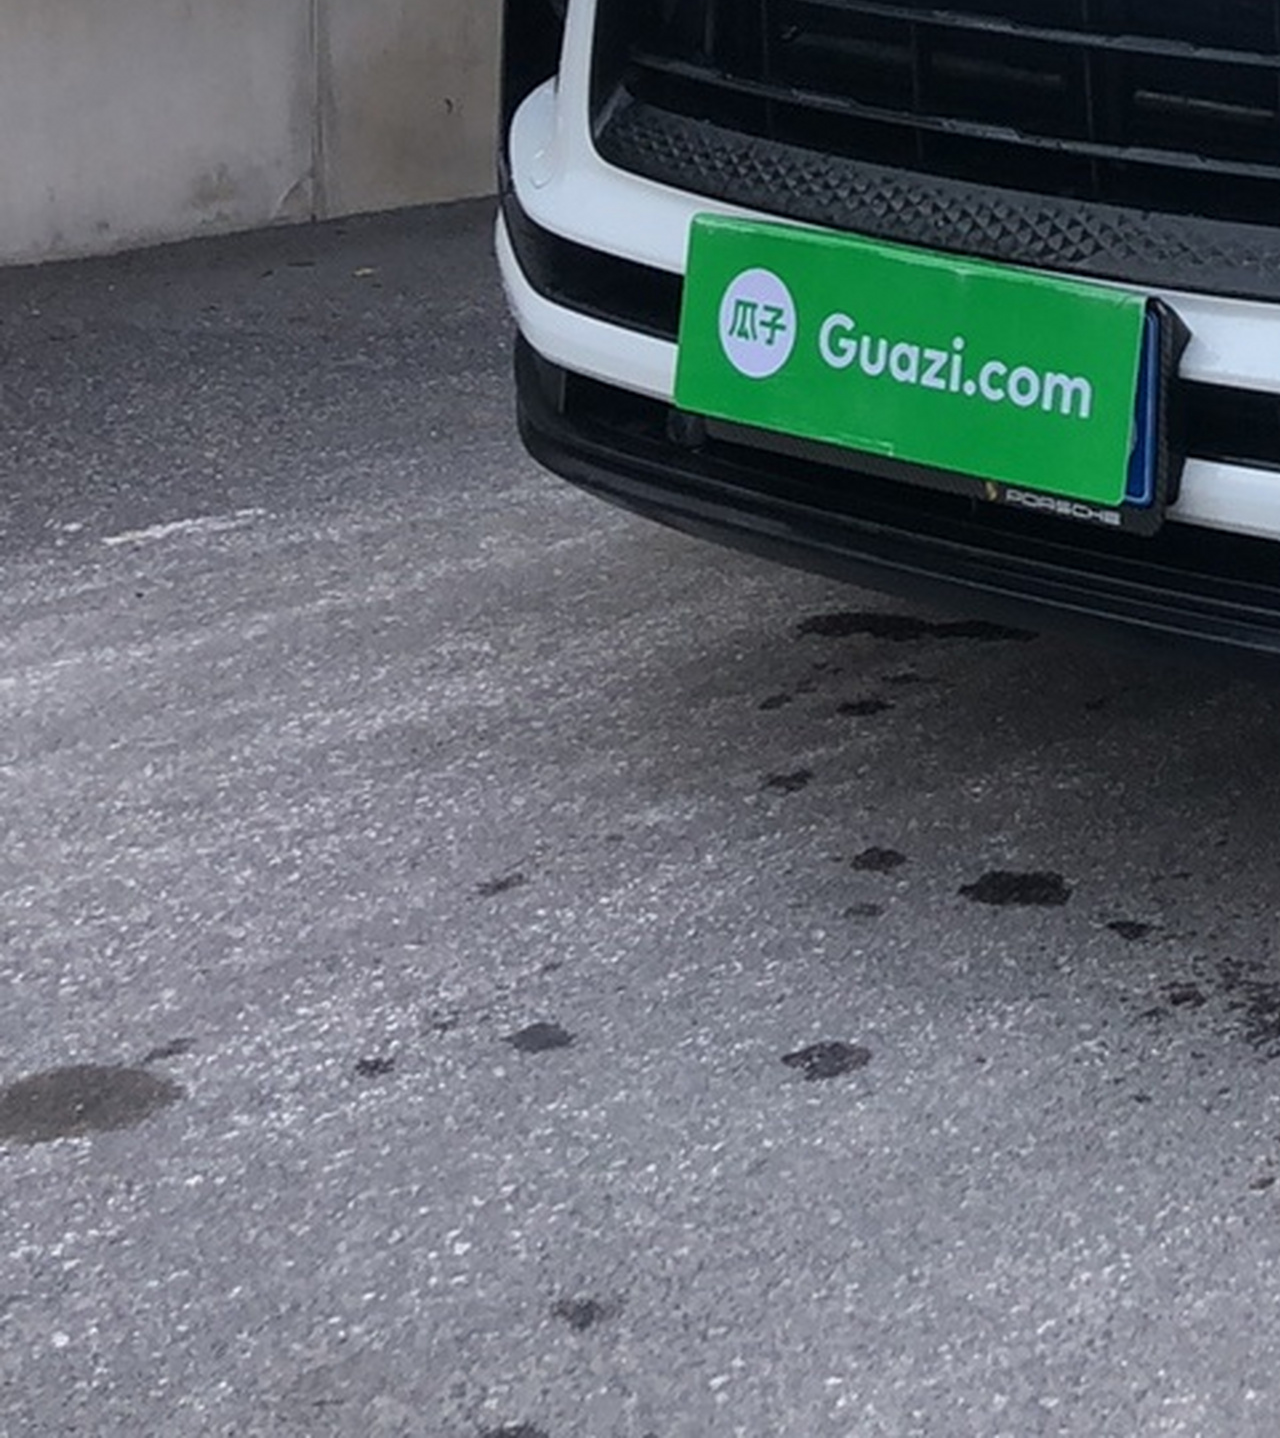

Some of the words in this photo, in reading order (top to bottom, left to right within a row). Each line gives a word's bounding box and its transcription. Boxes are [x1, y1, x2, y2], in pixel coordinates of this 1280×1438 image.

[728, 299, 787, 347] 瓜子
[818, 312, 1092, 419] Guazi.com
[1005, 489, 1122, 526] PORSCHE
